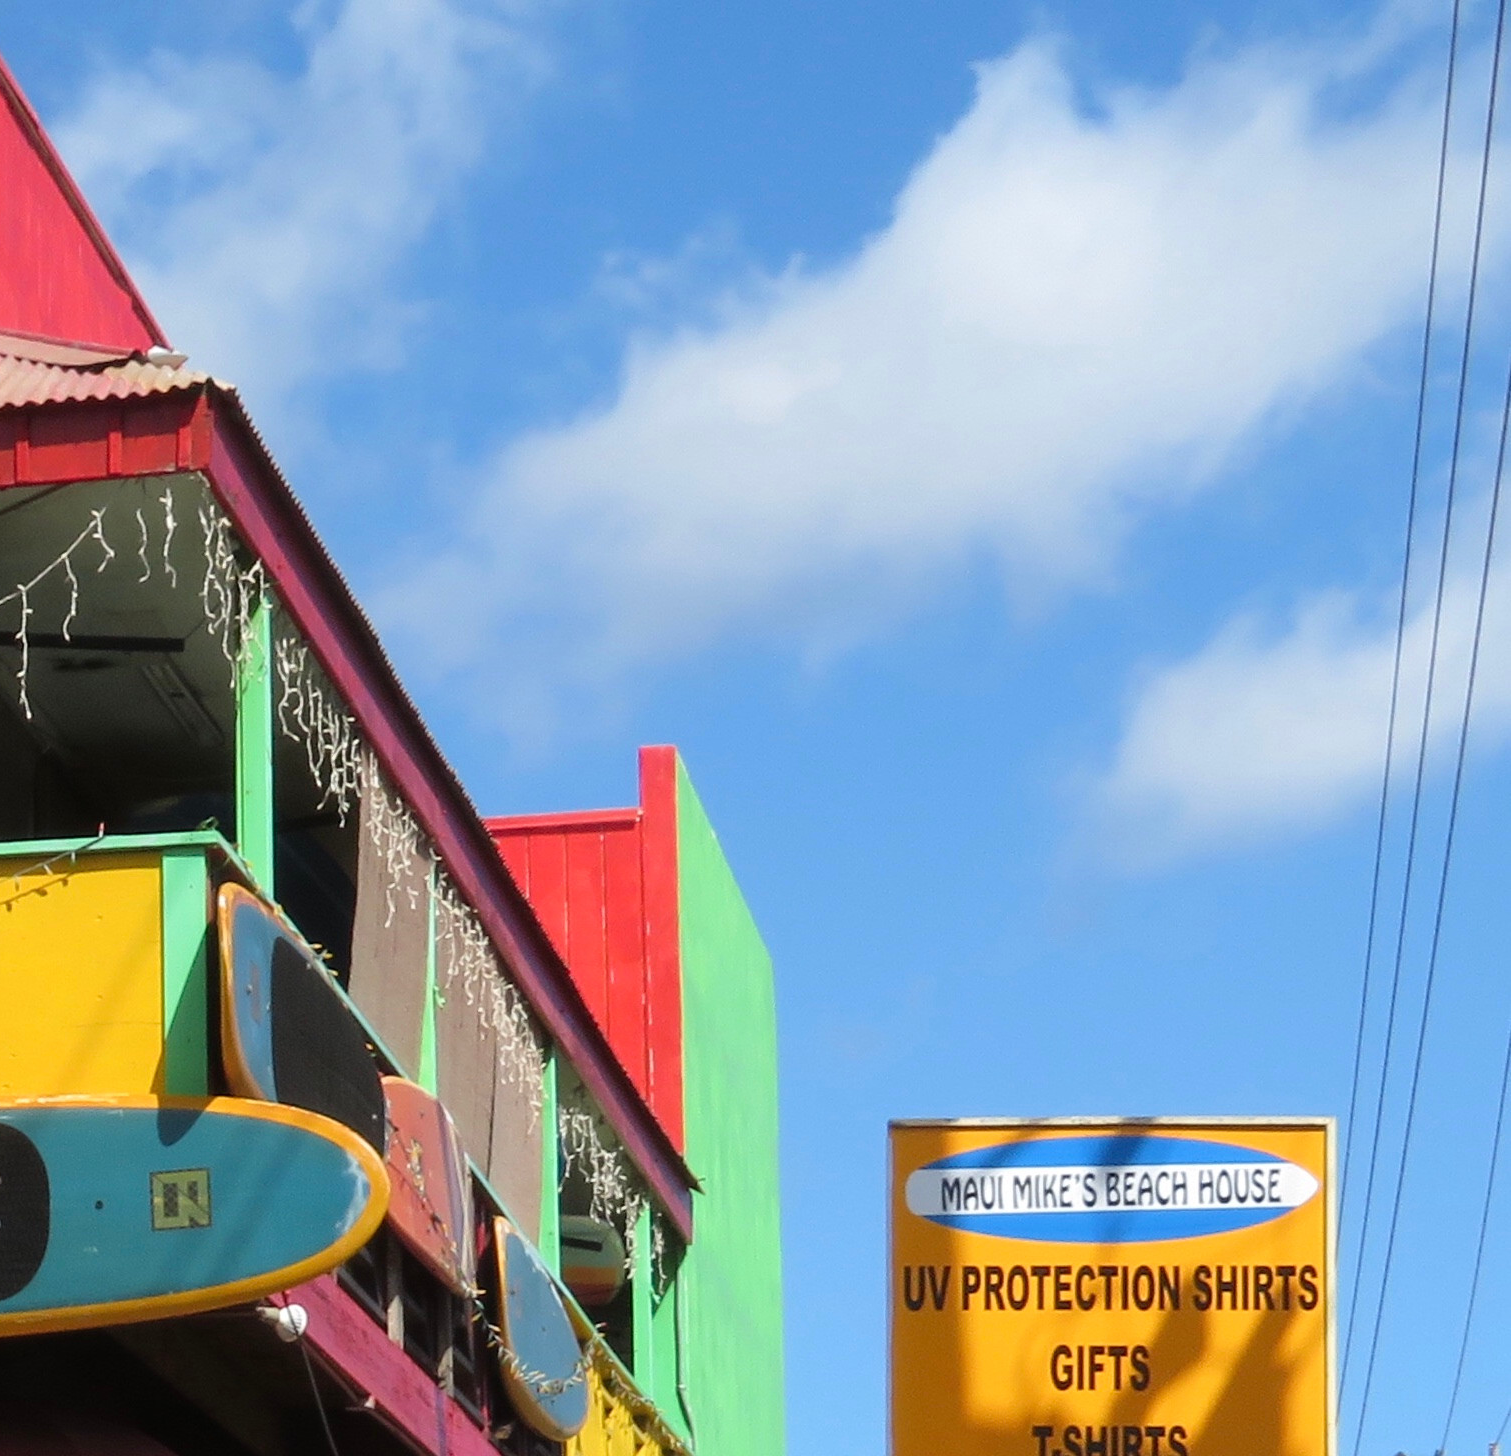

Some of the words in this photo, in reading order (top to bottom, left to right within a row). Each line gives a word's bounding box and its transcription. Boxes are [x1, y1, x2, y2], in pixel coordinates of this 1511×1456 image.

[940, 1175, 1005, 1212] MAUI
[1012, 1173, 1098, 1209] MIKE'S
[1105, 1170, 1189, 1207] BEACH
[1197, 1168, 1282, 1205] HOUSE
[902, 1265, 951, 1311] UV
[961, 1264, 1181, 1312] PROTECTION
[1192, 1264, 1320, 1312] SHIRTS
[1050, 1345, 1150, 1391] GIFTS
